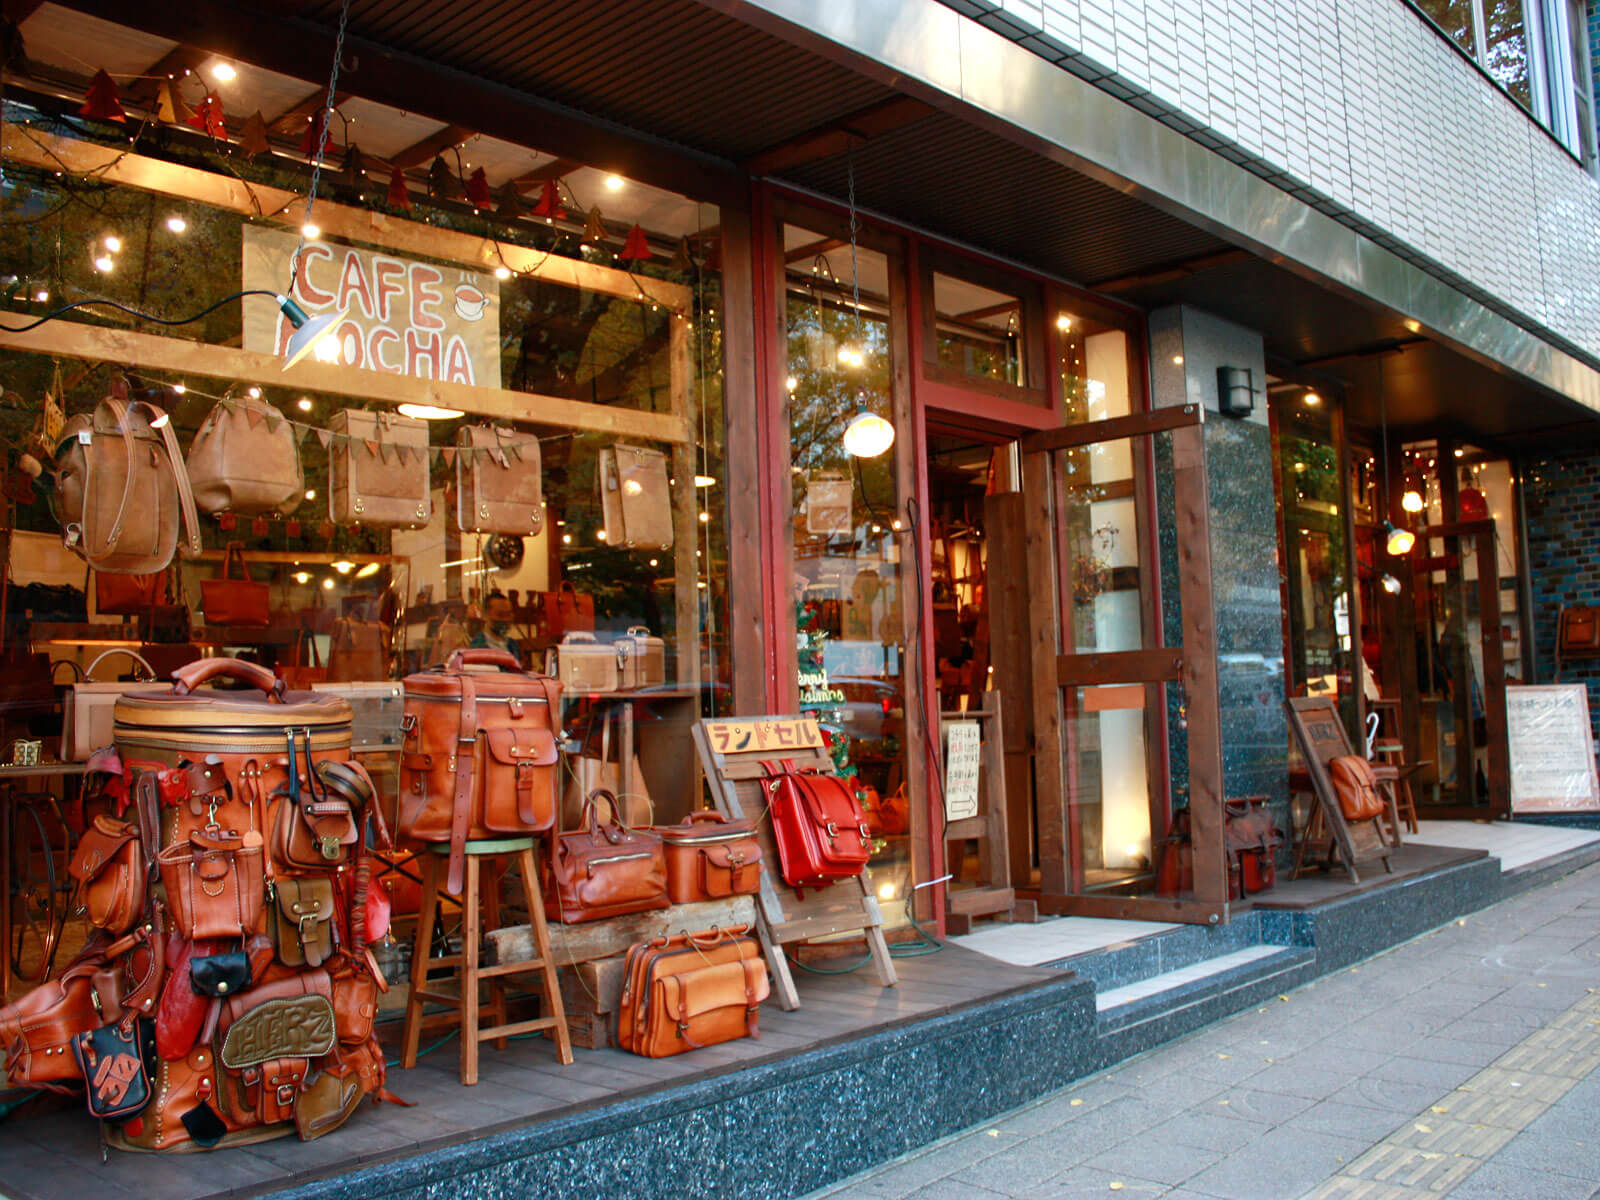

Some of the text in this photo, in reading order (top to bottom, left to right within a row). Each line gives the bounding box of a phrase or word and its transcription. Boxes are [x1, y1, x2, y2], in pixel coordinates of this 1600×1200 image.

[290, 243, 446, 331] CAFE
[797, 668, 828, 690] erry
[713, 721, 817, 750] ランドセル
